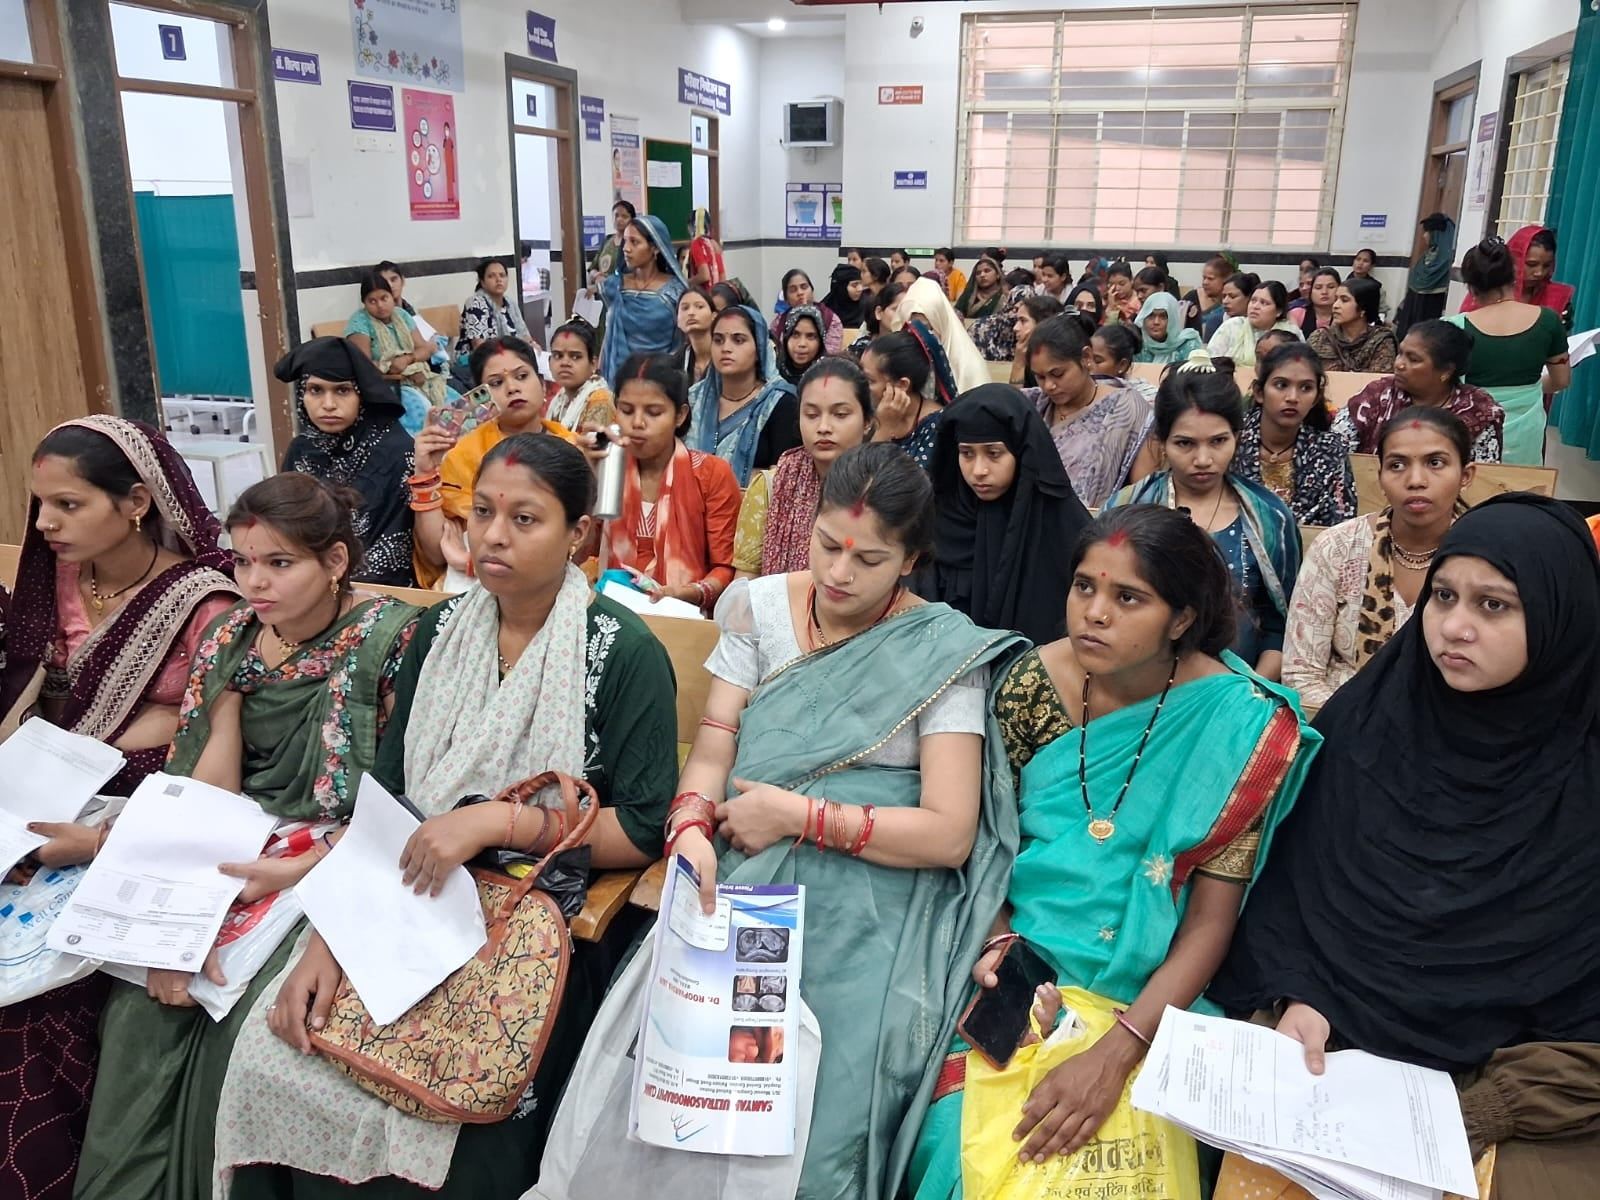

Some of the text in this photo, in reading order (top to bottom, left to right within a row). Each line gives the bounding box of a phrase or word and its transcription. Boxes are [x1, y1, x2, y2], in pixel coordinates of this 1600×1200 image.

[684, 72, 700, 90] परिवार
[684, 87, 727, 110] Family Planning Room
[707, 996, 720, 1005] Dr.
[655, 1087, 731, 1112] ULTRASONOGRAPHY
